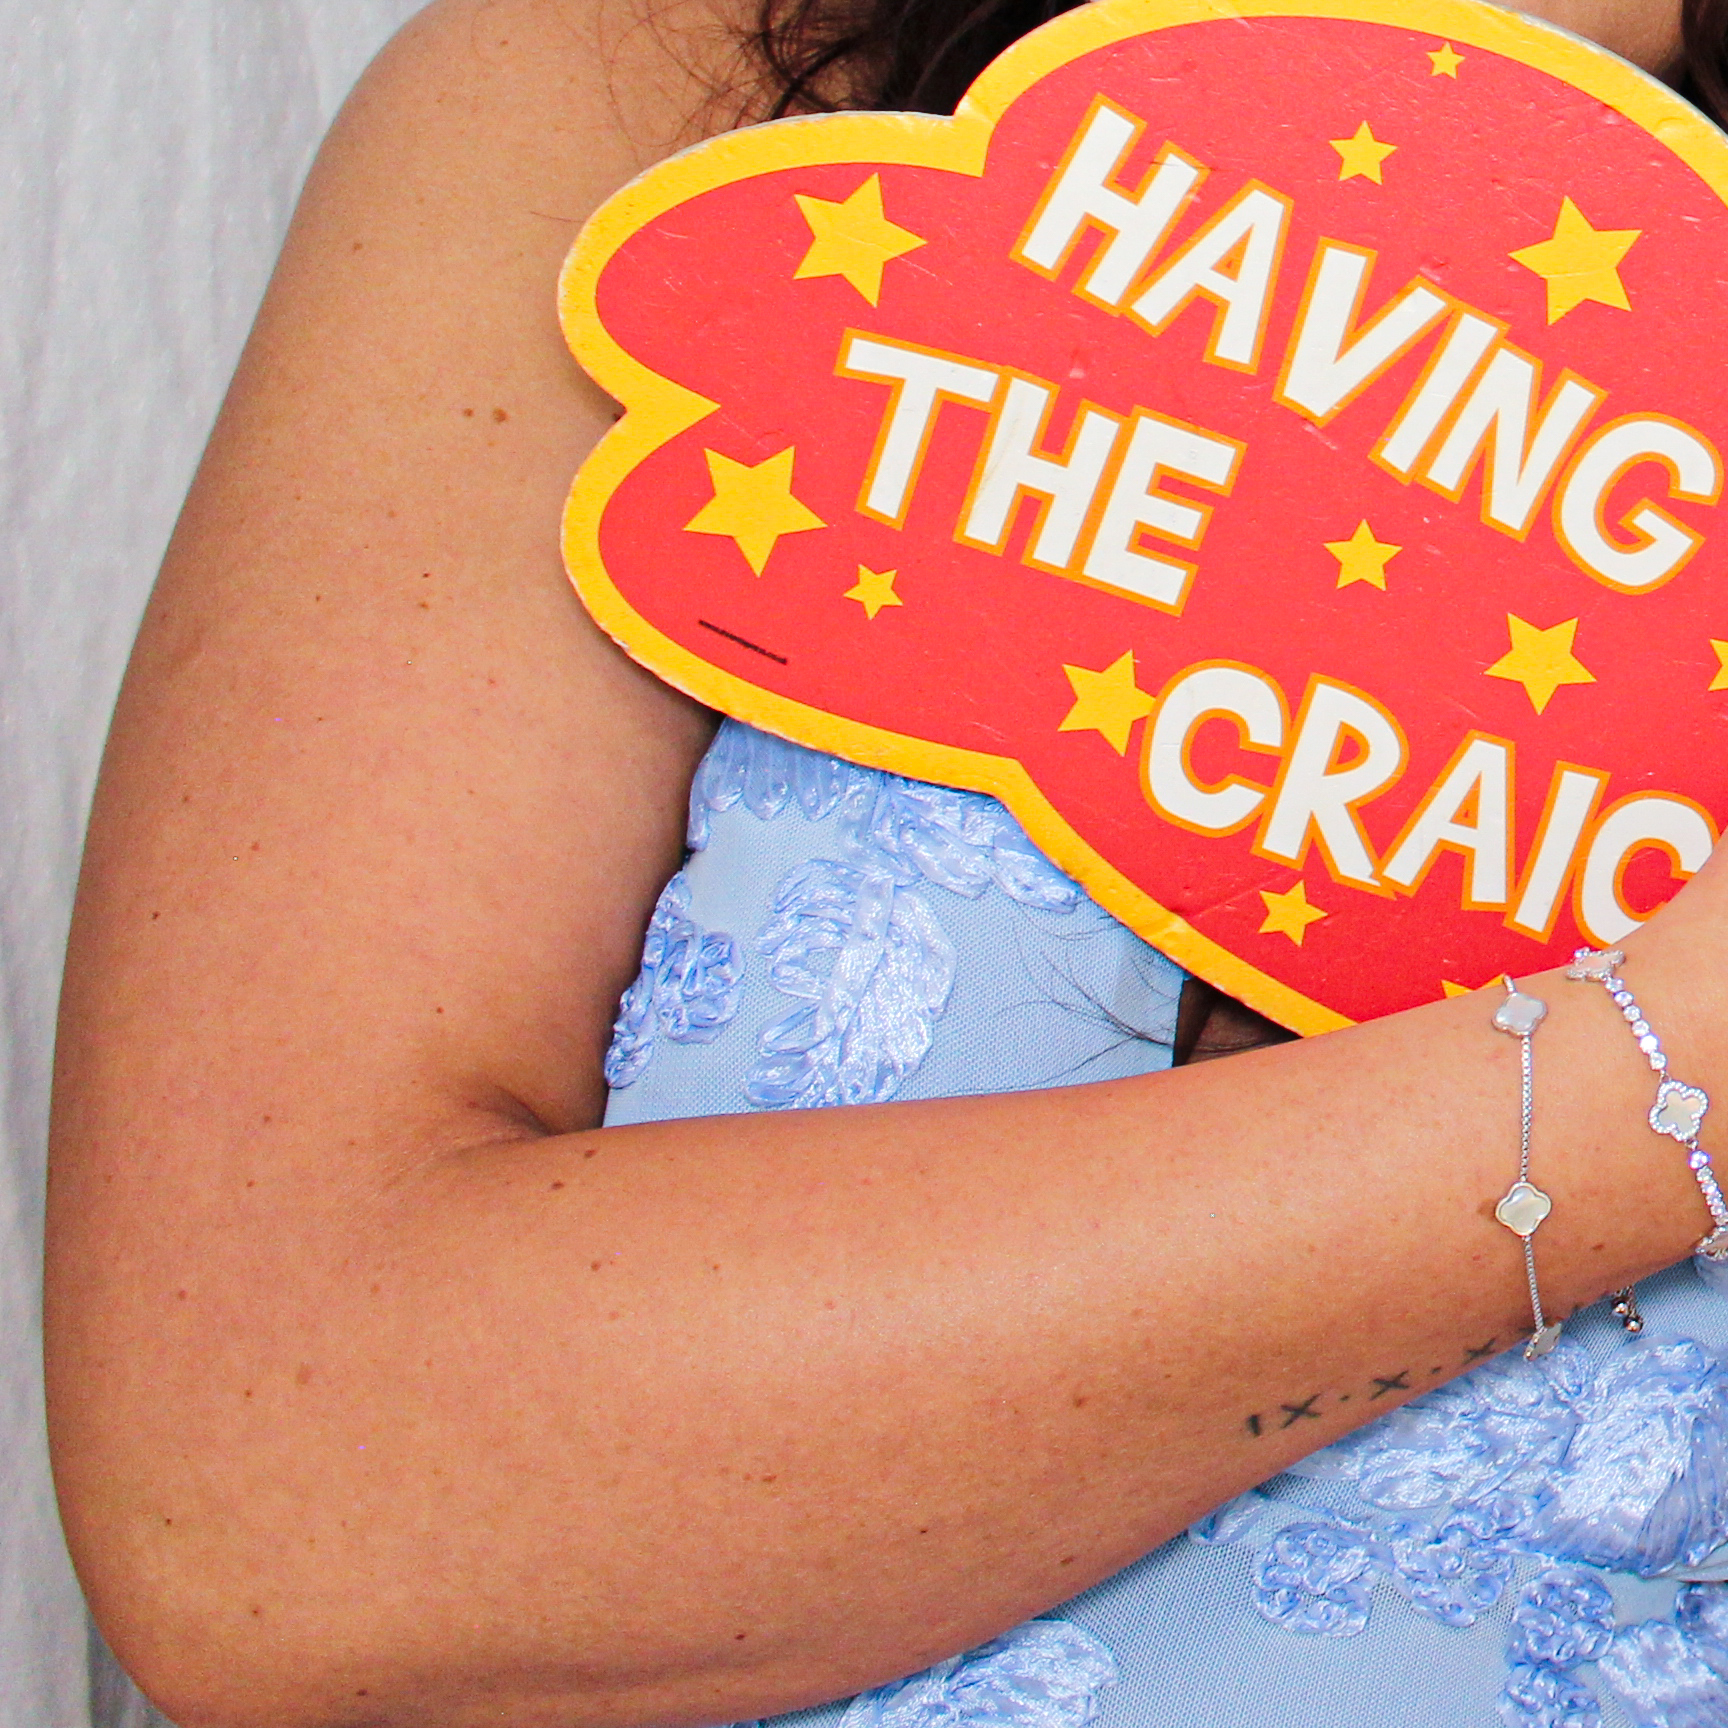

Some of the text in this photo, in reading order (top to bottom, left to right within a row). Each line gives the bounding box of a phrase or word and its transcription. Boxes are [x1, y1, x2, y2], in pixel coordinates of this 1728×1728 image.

[836, 330, 1245, 613] THE
[1012, 98, 1723, 592] HAVING
[1142, 661, 1720, 948] CRAIC
